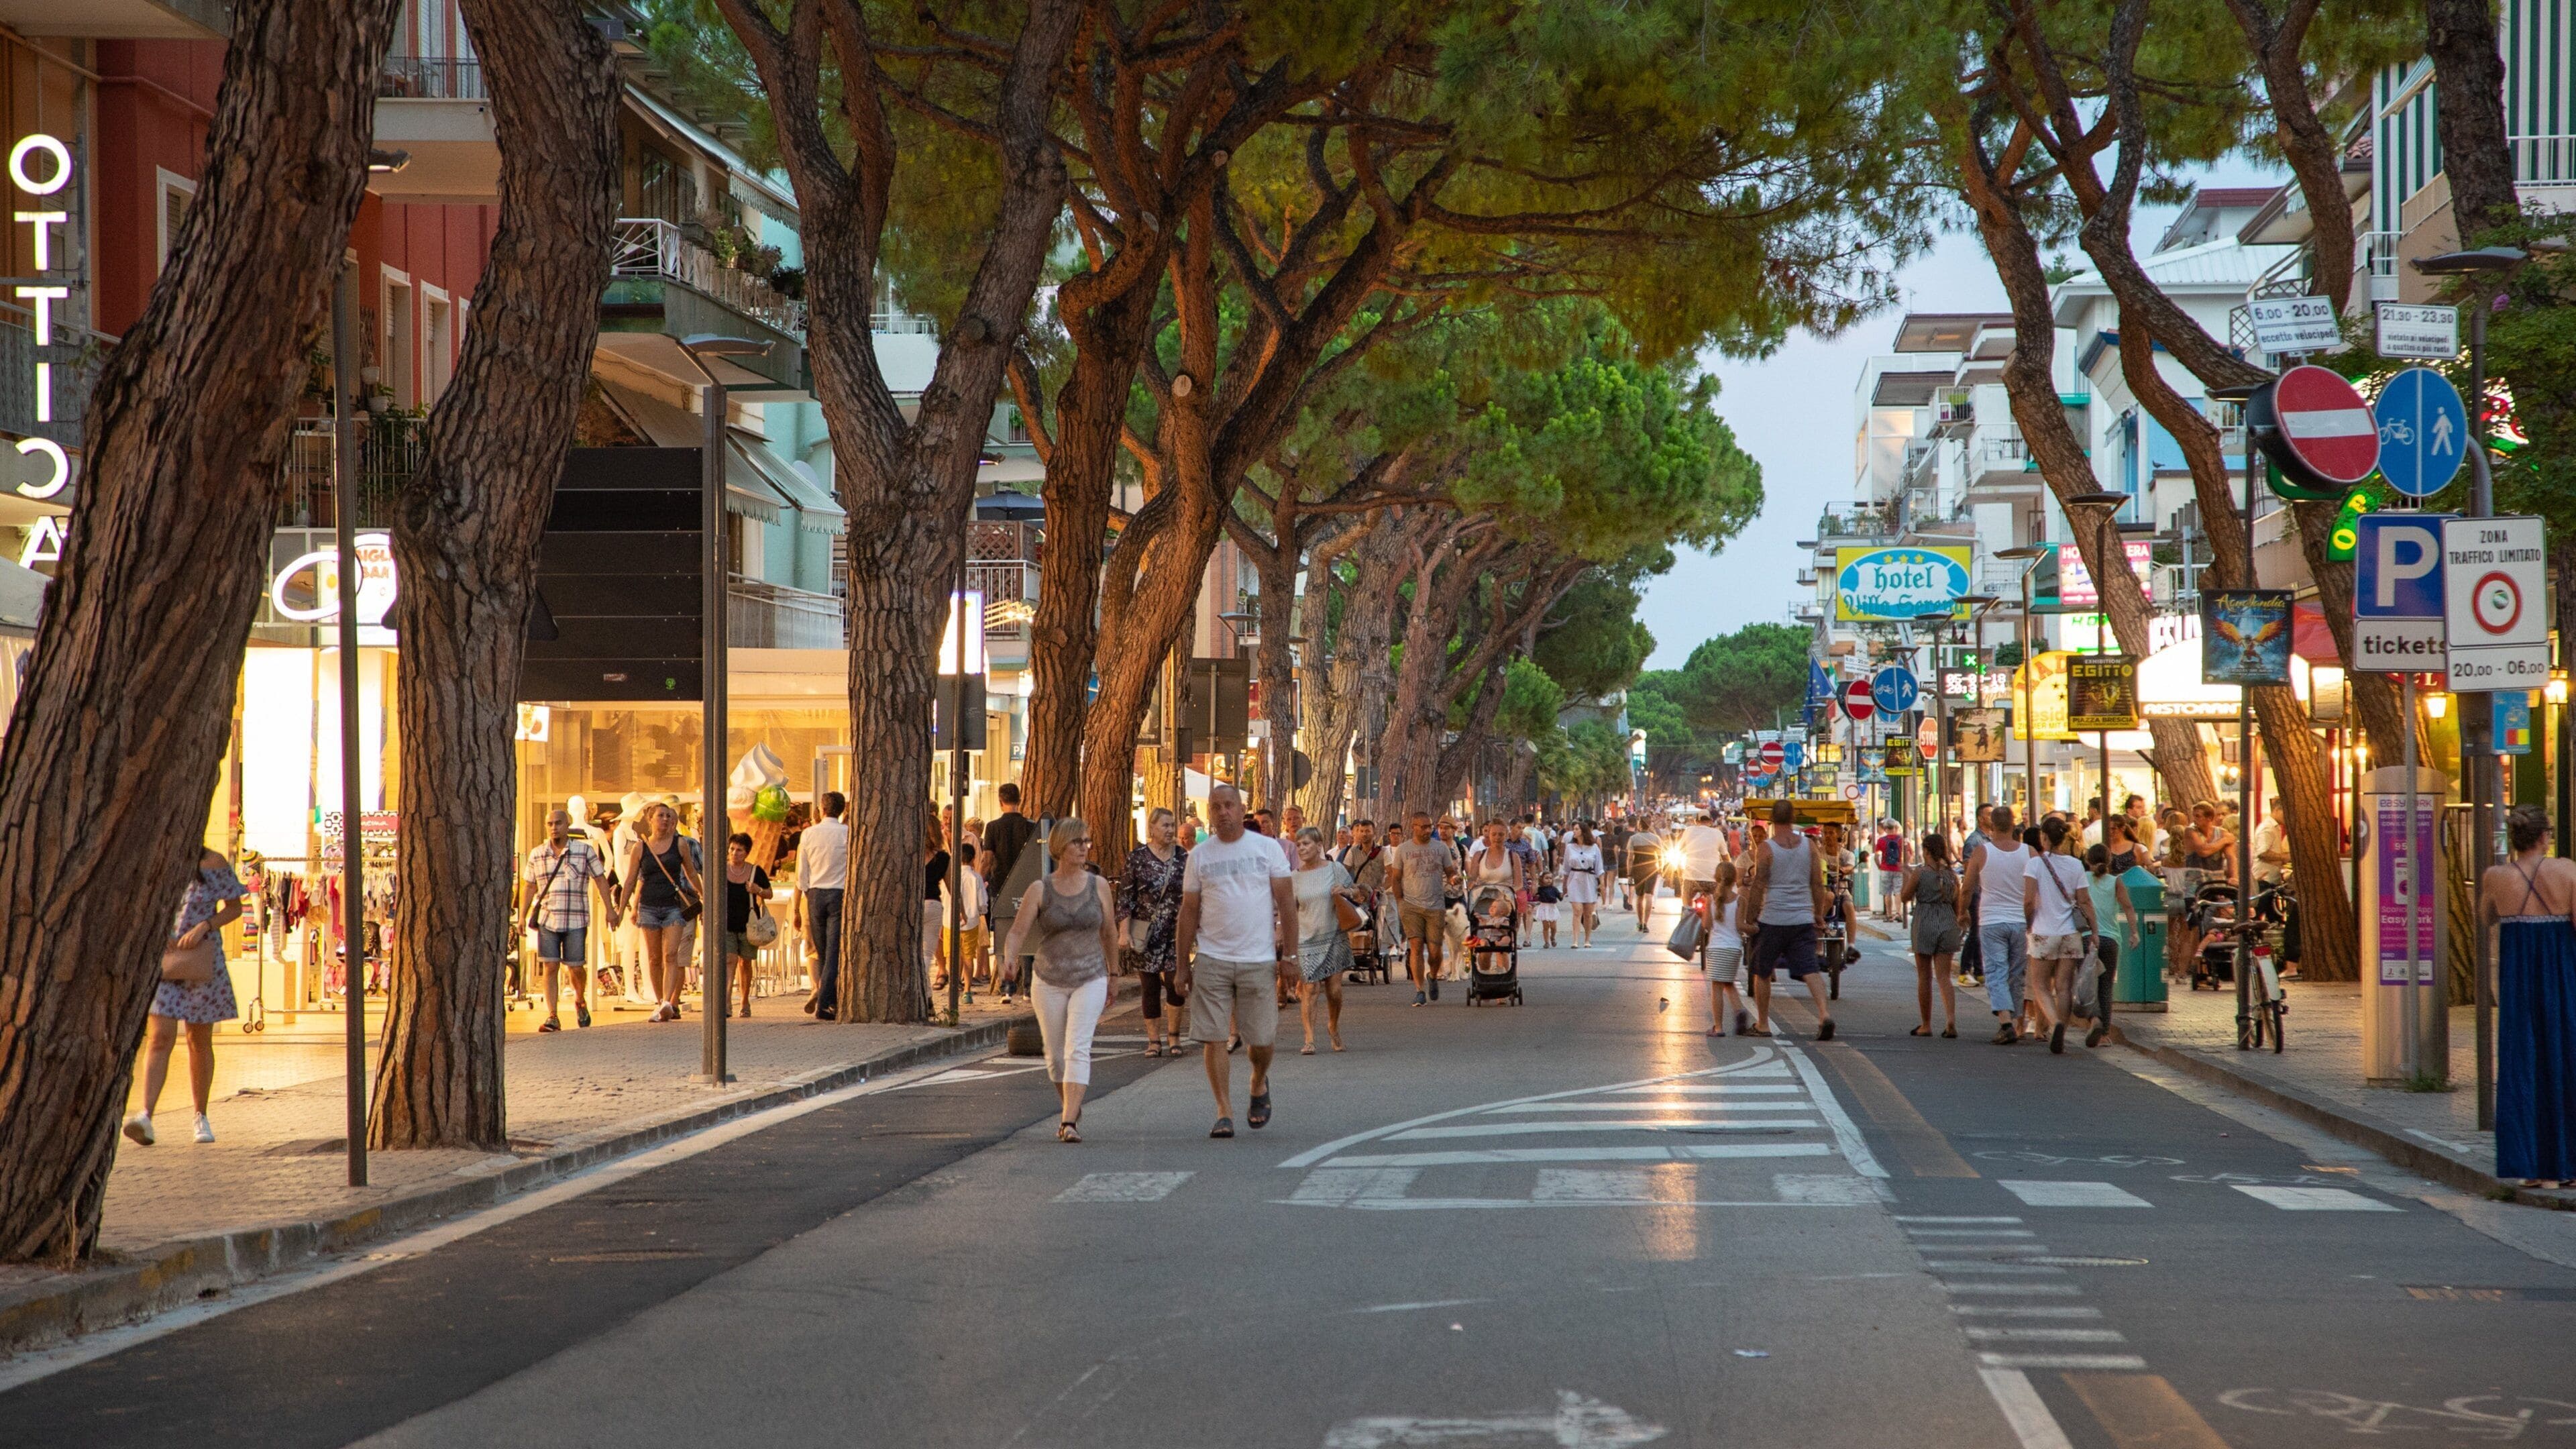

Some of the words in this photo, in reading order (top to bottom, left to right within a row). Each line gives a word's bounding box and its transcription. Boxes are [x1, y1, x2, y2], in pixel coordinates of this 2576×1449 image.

[2292, 304, 2330, 317] 20.00
[2382, 308, 2412, 321] 21.30
[2422, 310, 2454, 323] 23.30
[2261, 331, 2292, 342] eccetto
[2295, 329, 2337, 341] velocipedi
[2481, 530, 2508, 543] ZONA
[2449, 550, 2494, 565] TRAFFICO
[2500, 549, 2541, 563] LIMITATO
[2377, 526, 2440, 607] P
[1874, 565, 1934, 594] hotel
[1843, 594, 1890, 616] Villa
[2072, 664, 2133, 678] EGITTO
[2453, 662, 2493, 678] 20.00
[2508, 660, 2544, 676] 06.00
[2381, 915, 2432, 926] Easyark
